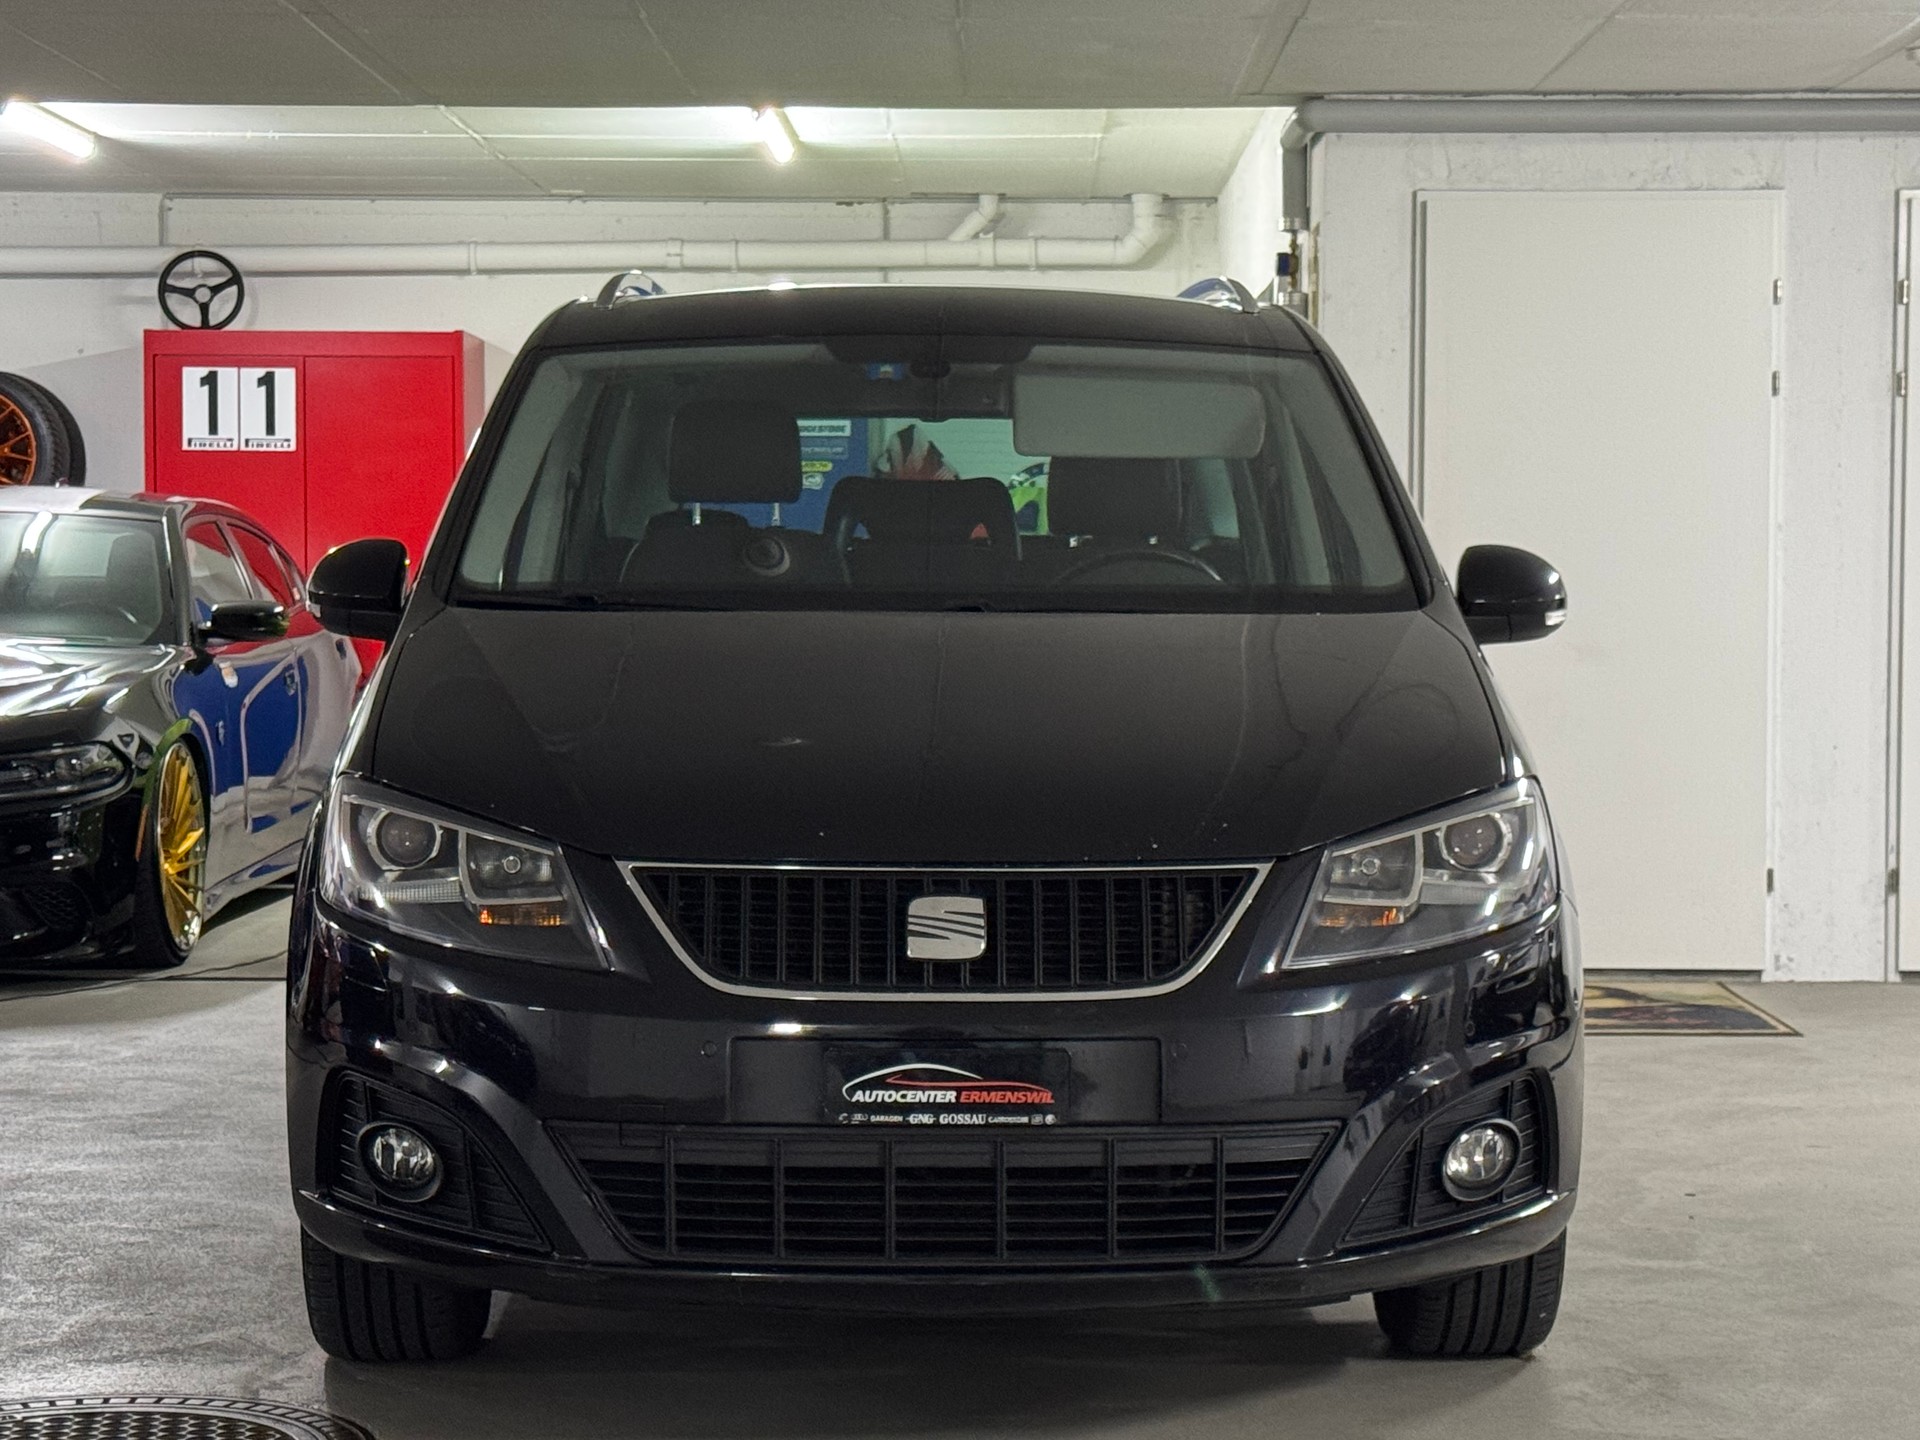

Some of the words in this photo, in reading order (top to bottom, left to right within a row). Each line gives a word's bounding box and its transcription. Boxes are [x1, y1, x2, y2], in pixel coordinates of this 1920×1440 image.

[850, 1090, 956, 1103] AUTOCENTER
[959, 1090, 1055, 1104] ERMENSWIL
[939, 1113, 987, 1125] GOSSAU
